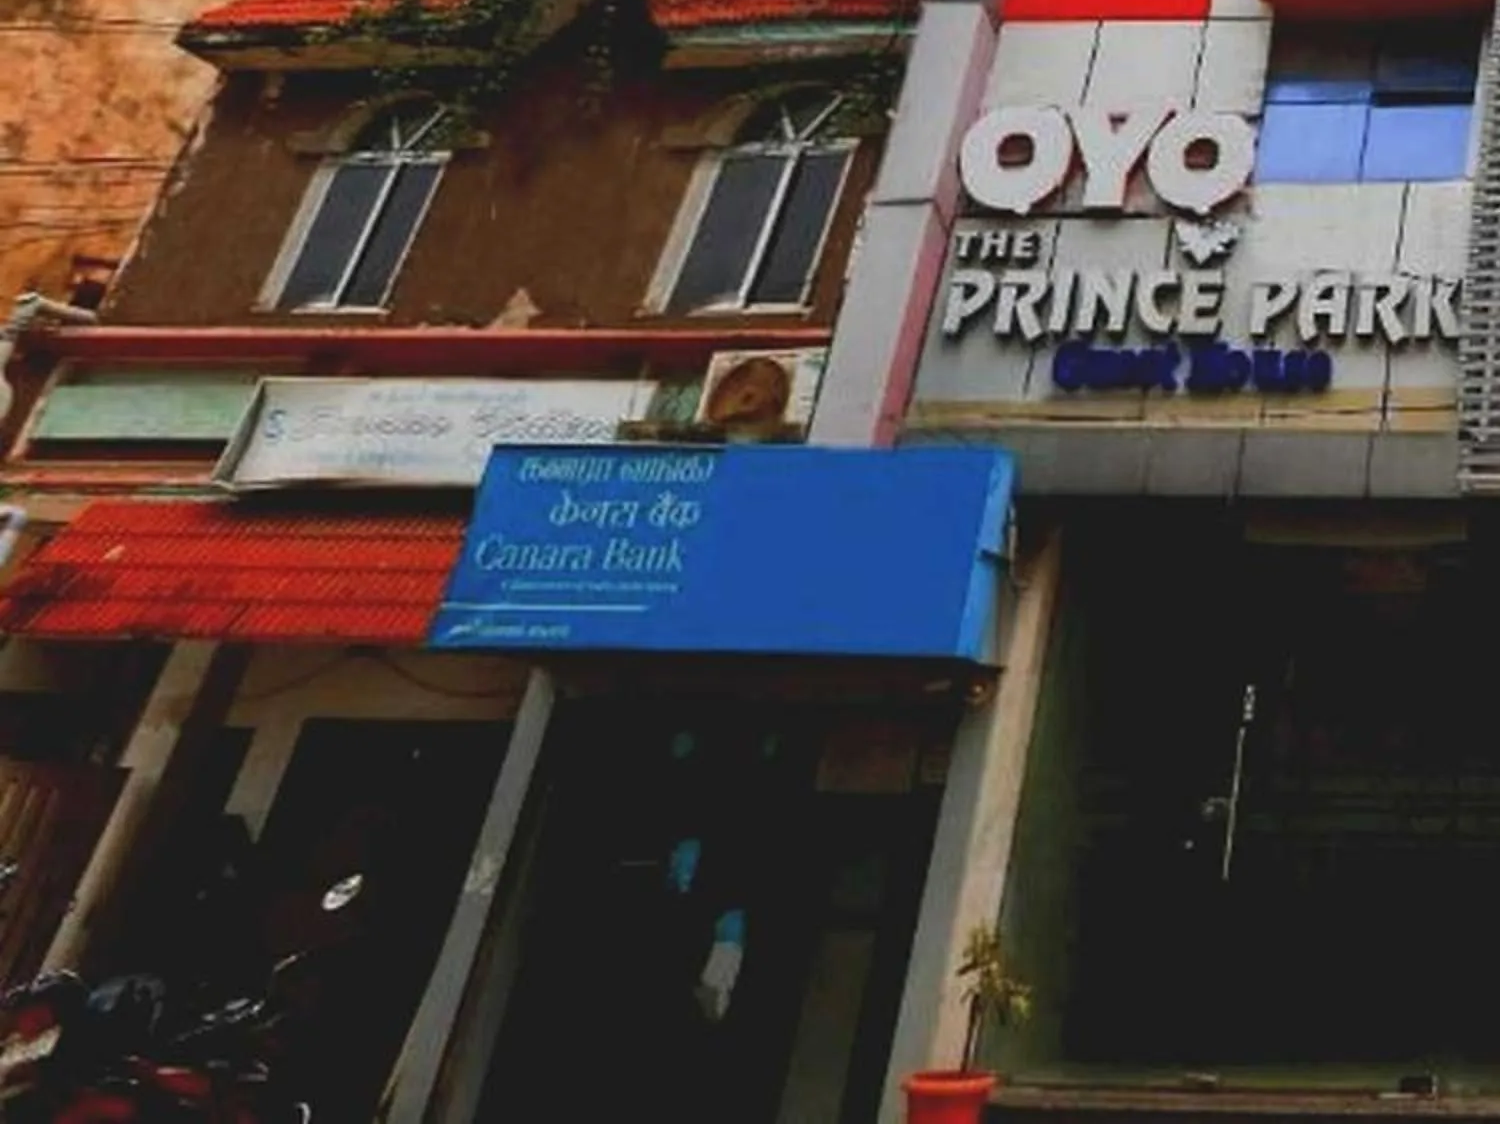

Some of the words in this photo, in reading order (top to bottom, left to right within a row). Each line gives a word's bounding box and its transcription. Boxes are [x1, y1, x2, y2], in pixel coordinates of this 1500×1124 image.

[958, 106, 1258, 216] OYO
[955, 230, 1042, 260] THE
[942, 270, 1226, 342] PRINCE
[1250, 271, 1462, 344] PARK
[474, 534, 592, 571] Canara
[602, 537, 684, 572] Bank
